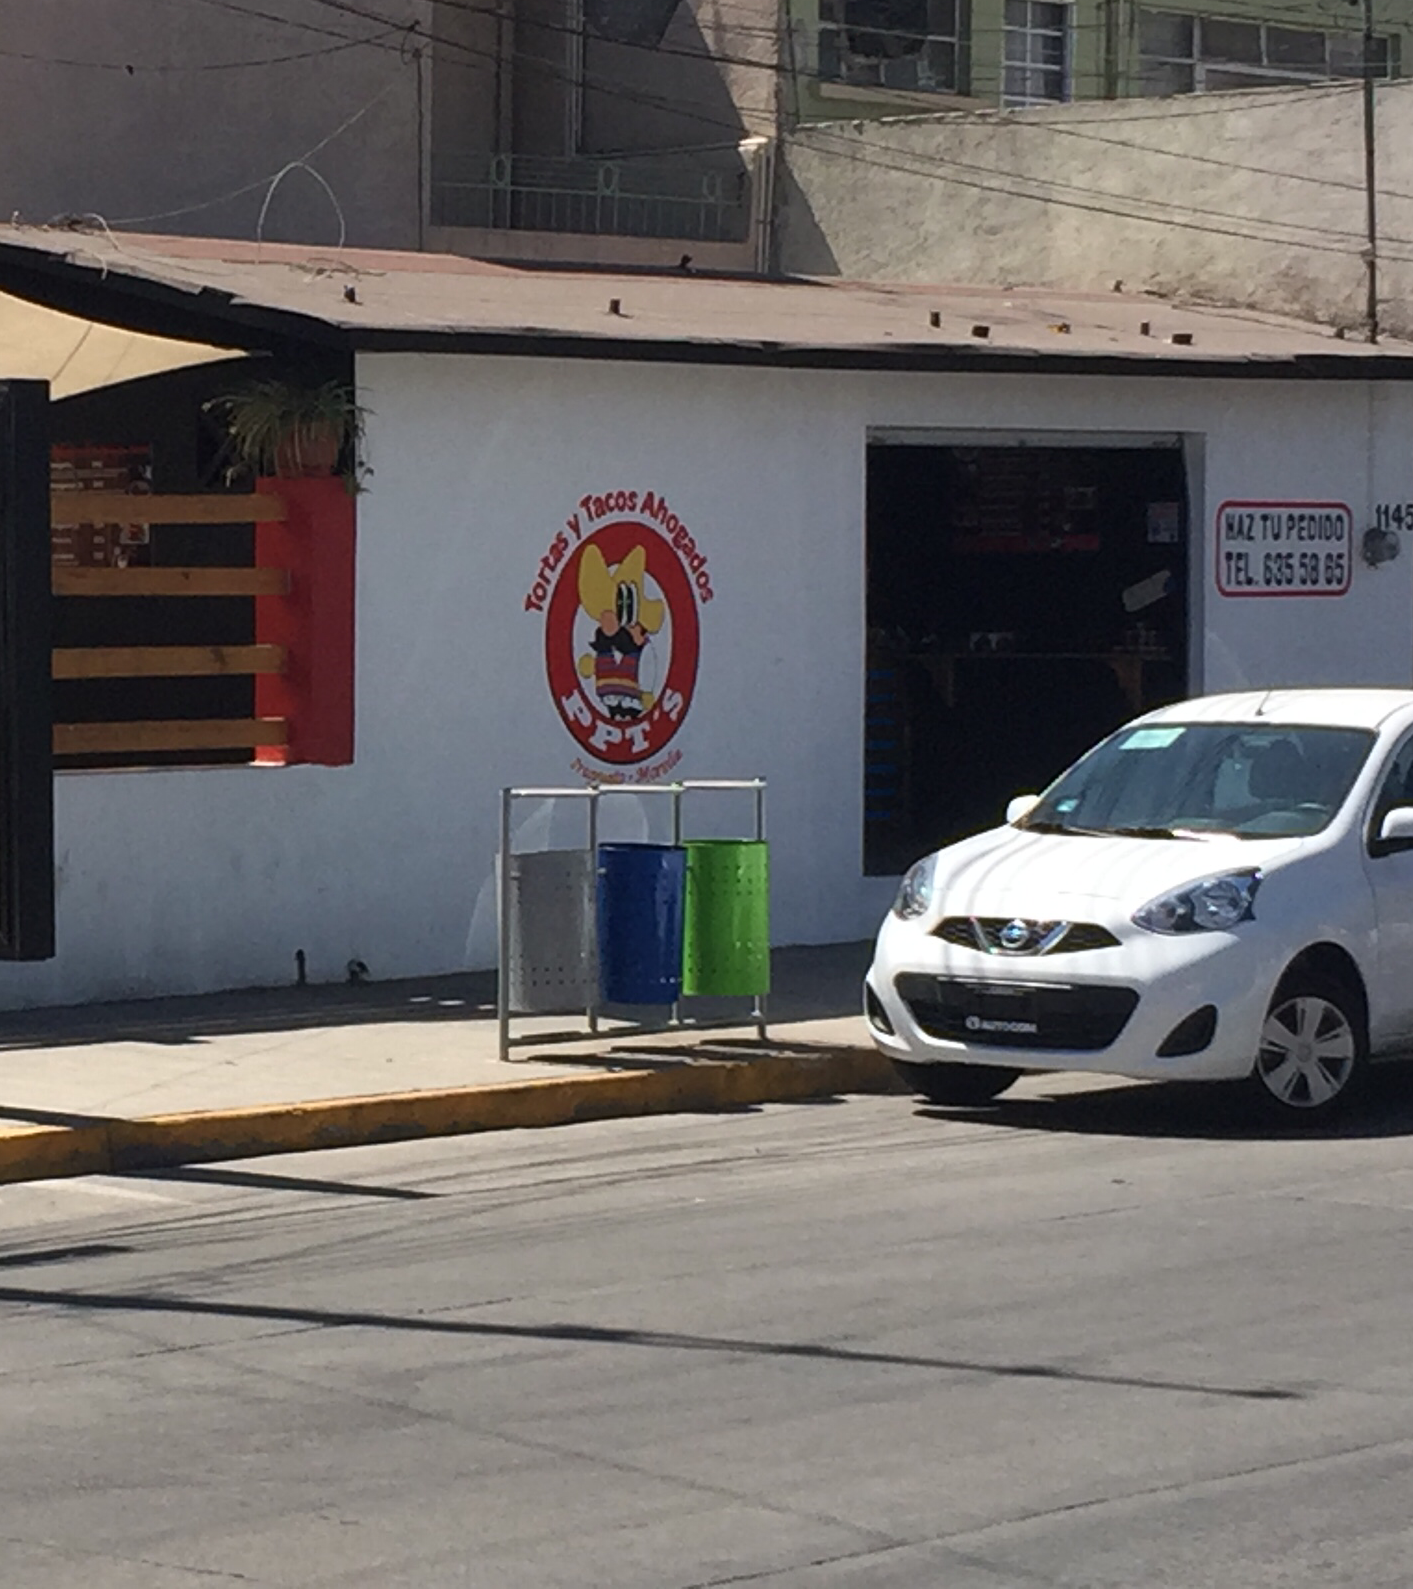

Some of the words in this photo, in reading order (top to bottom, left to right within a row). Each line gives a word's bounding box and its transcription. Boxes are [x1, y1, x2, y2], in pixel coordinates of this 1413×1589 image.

[1225, 513, 1255, 541] HAZ
[1260, 513, 1282, 541] TU
[1286, 513, 1345, 541] PEDIDO
[524, 531, 569, 612] Tortas
[566, 513, 582, 541] y
[579, 490, 638, 522] Tacos
[640, 491, 713, 604] Ahogados
[1225, 551, 1259, 586] TEL.
